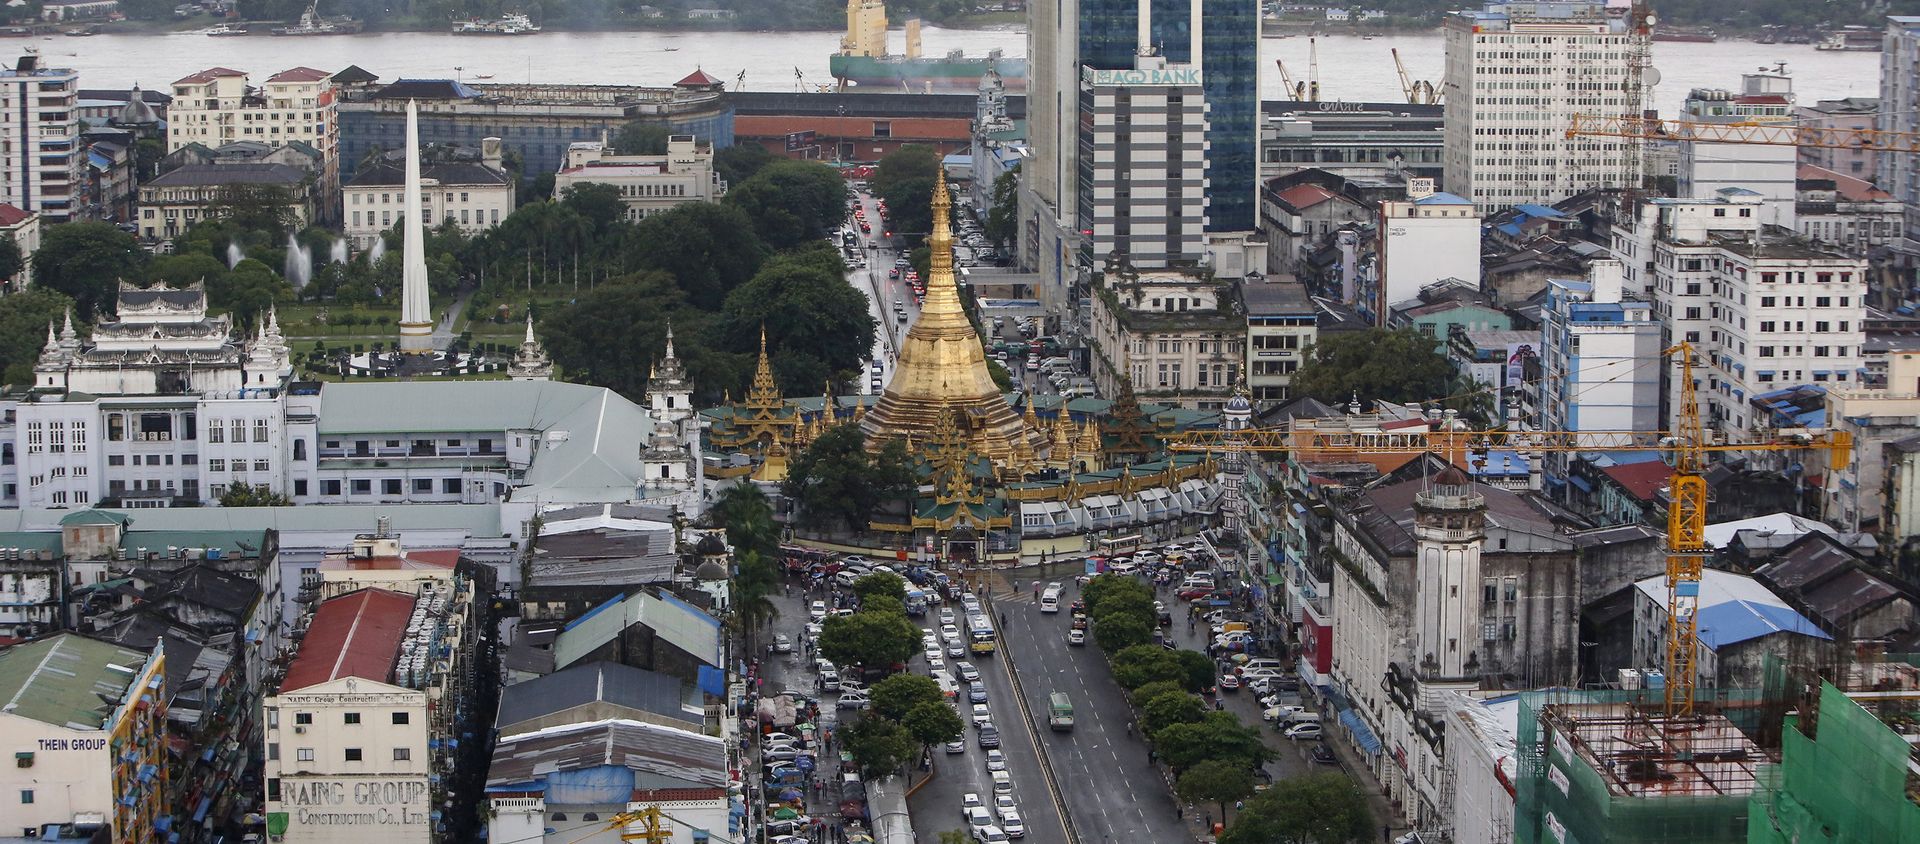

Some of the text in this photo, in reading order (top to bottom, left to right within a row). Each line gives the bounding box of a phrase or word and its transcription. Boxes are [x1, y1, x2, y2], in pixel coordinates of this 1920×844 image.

[1114, 69, 1199, 84] AGD BANK
[38, 739, 106, 751] THEIN GROUP
[284, 781, 426, 806] NAING GROUP
